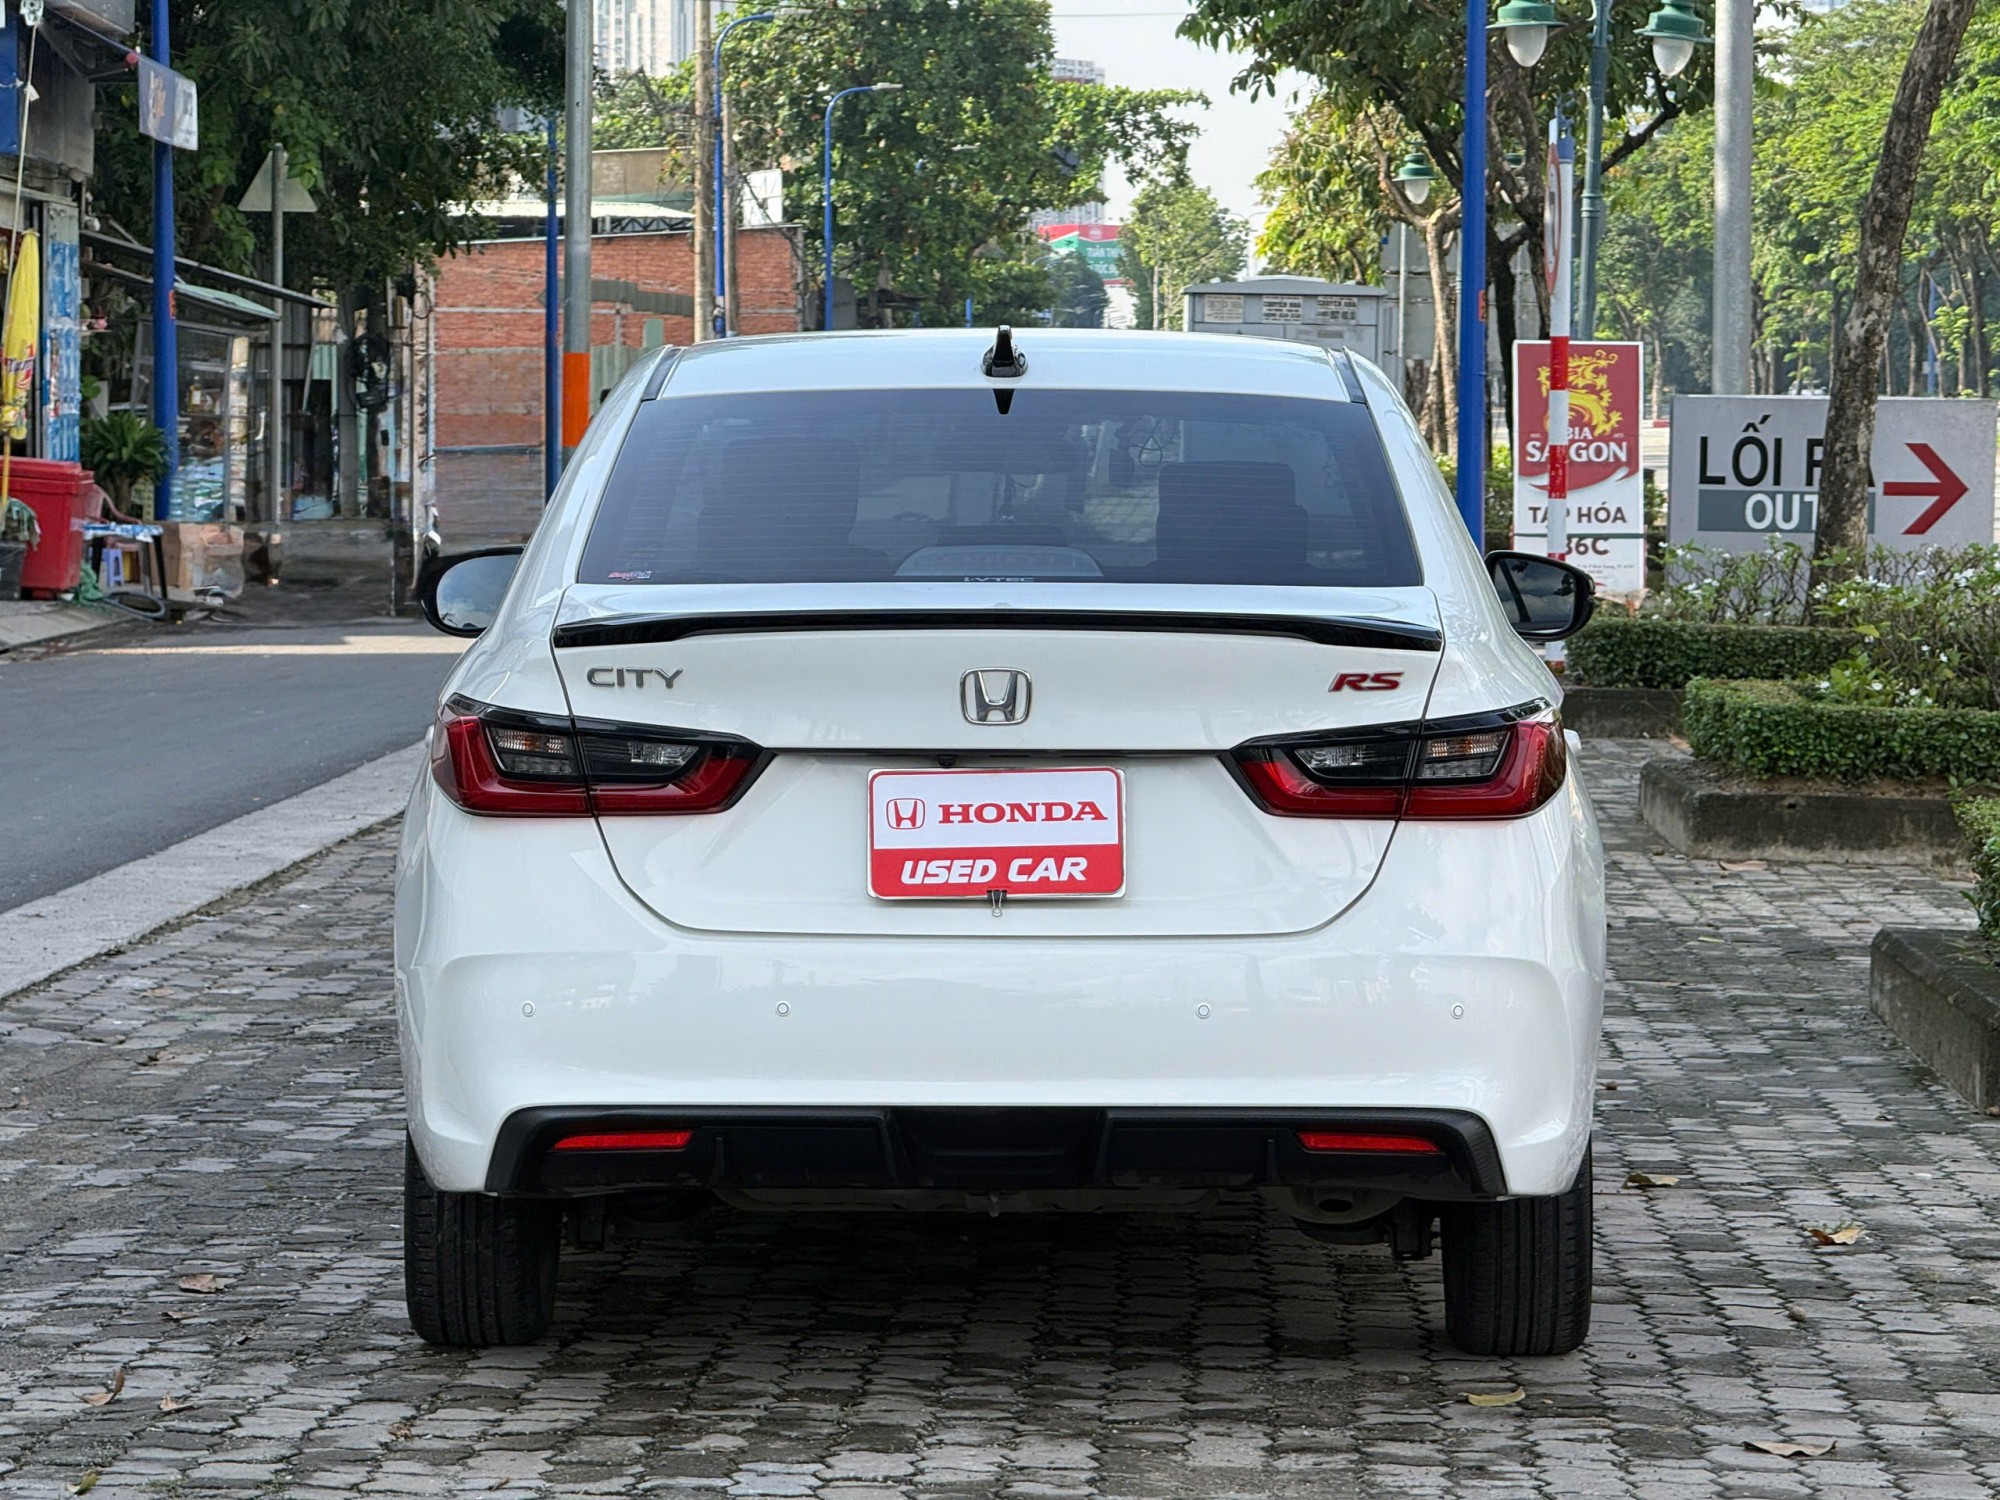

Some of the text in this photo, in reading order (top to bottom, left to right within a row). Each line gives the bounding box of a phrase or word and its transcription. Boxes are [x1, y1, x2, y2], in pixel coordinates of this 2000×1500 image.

[1699, 414, 1783, 487] LỐI
[1577, 501, 1627, 524] HÓA
[586, 667, 684, 690] CITY
[1328, 671, 1405, 693] RS
[938, 801, 1108, 824] HONDA
[901, 856, 1088, 885] USED CAR
